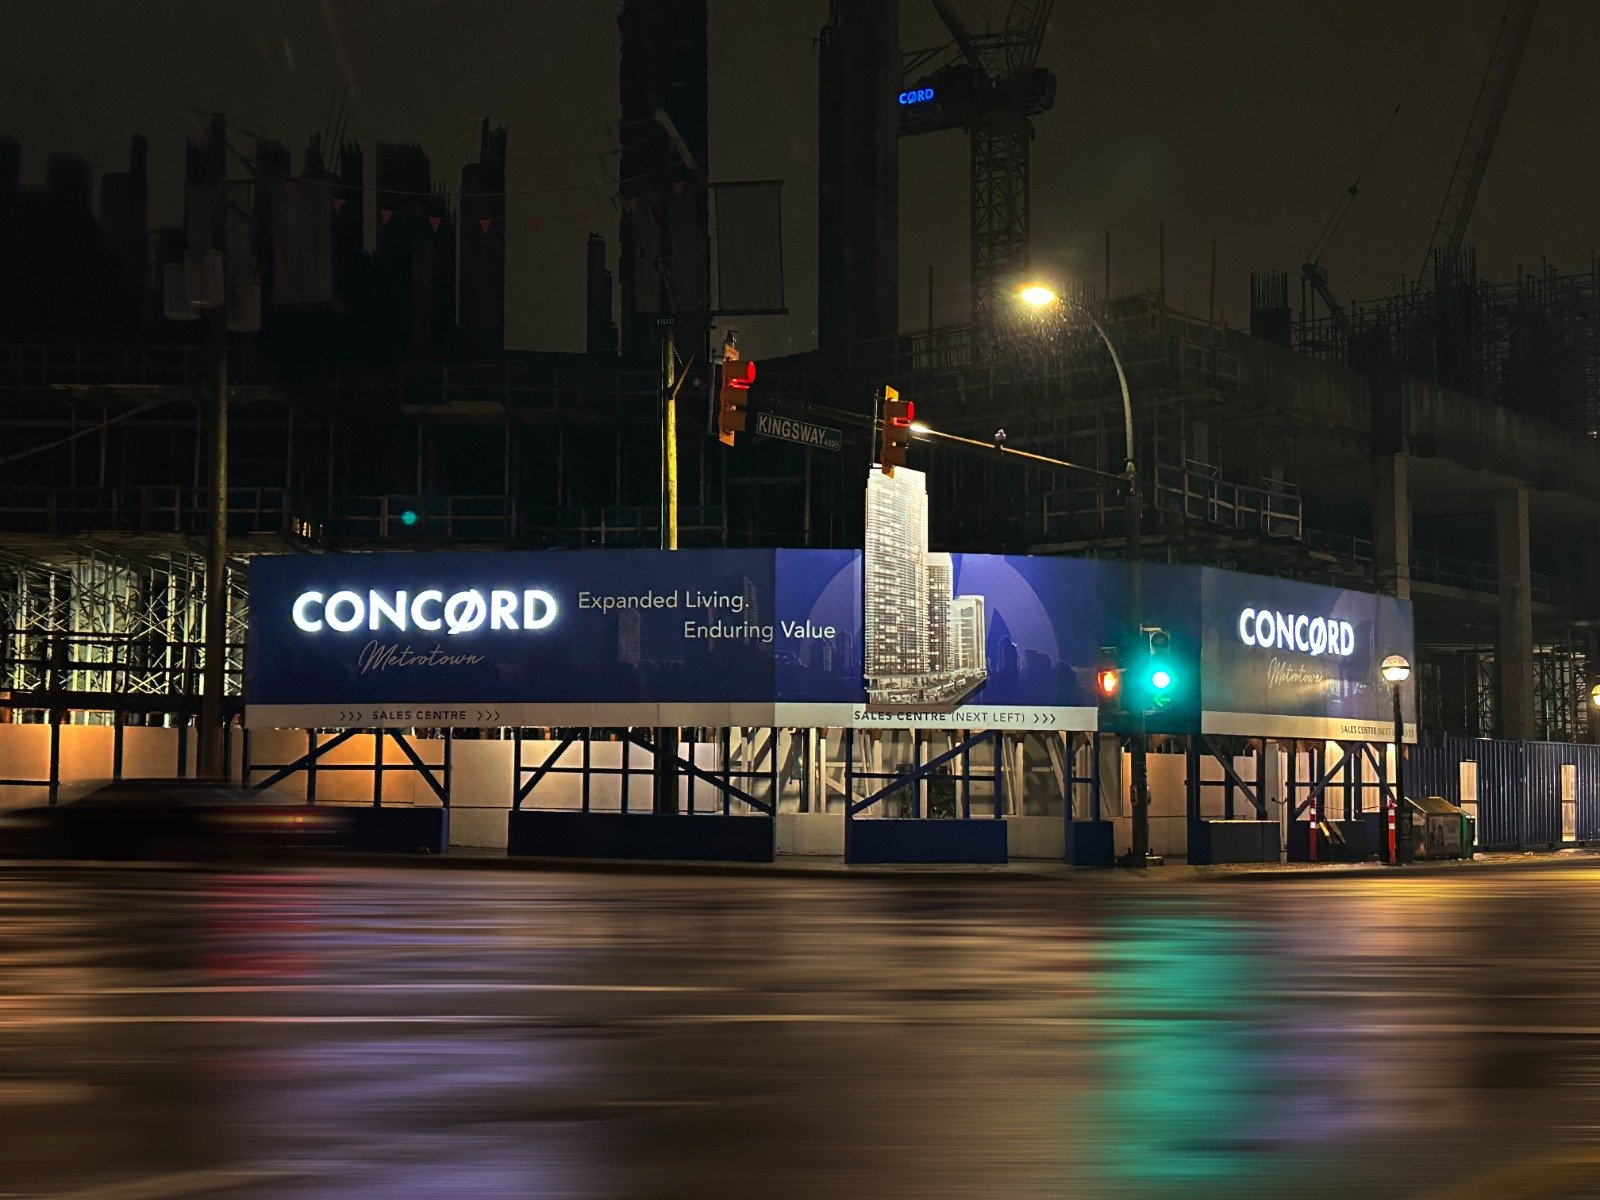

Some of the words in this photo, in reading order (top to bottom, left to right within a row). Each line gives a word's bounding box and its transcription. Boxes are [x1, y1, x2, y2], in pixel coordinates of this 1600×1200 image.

[759, 415, 826, 445] KINGSWAY
[578, 590, 678, 614] Expanded
[686, 590, 749, 613] Living.
[684, 620, 774, 643] Enduring
[780, 620, 836, 639] Value
[358, 639, 485, 675] Metrotown
[1267, 656, 1324, 689] Metrotown
[372, 710, 412, 720] SALES
[416, 710, 467, 720] CENTRE
[853, 710, 892, 721] SALES
[897, 711, 946, 721] CENTRE
[951, 711, 988, 722] (NEXT
[992, 712, 1026, 724] LEFT)
[1341, 725, 1357, 734] SALES
[1358, 725, 1377, 735] CENTRE
